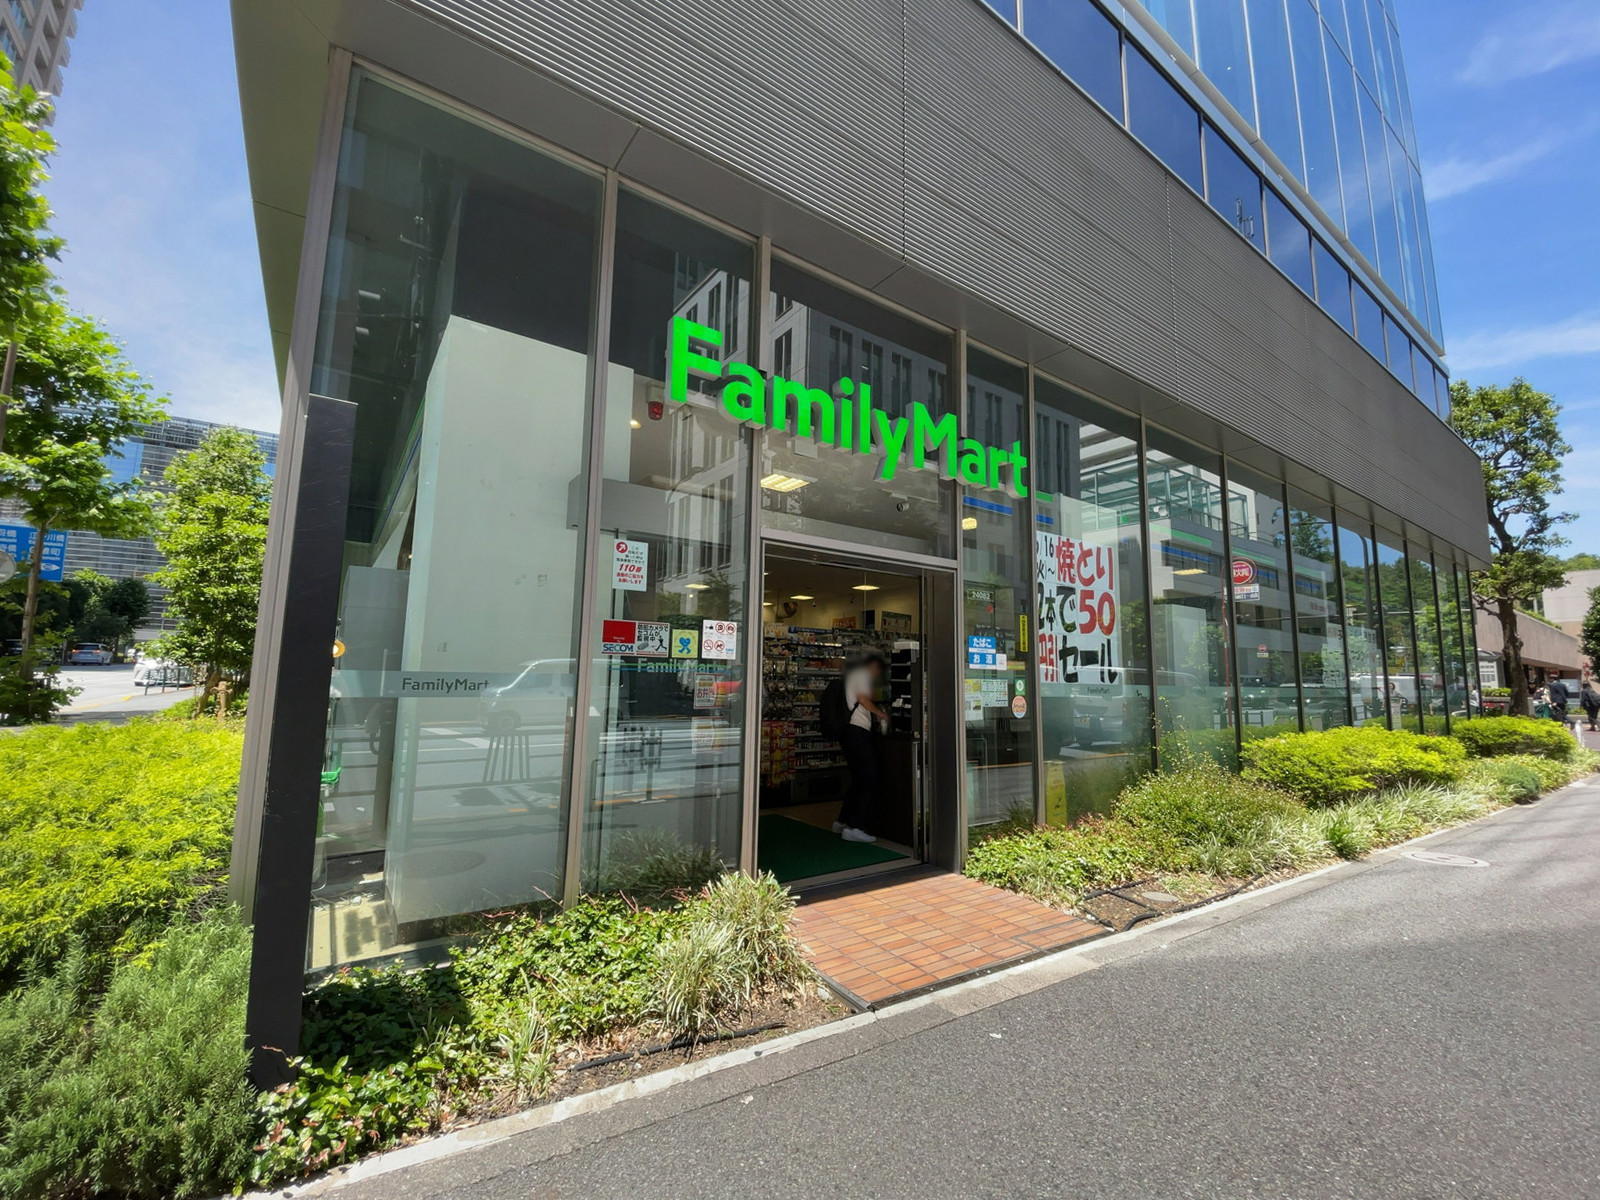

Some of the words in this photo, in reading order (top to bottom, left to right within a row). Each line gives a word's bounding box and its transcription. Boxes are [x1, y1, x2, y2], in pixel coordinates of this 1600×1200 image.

[668, 314, 1028, 499] FamilyMart
[1055, 536, 1114, 591] 焼とり
[603, 643, 634, 652] SECOM
[972, 637, 993, 648] たばこ
[638, 658, 721, 677] FamilyMart
[402, 677, 490, 694] FamilyMart
